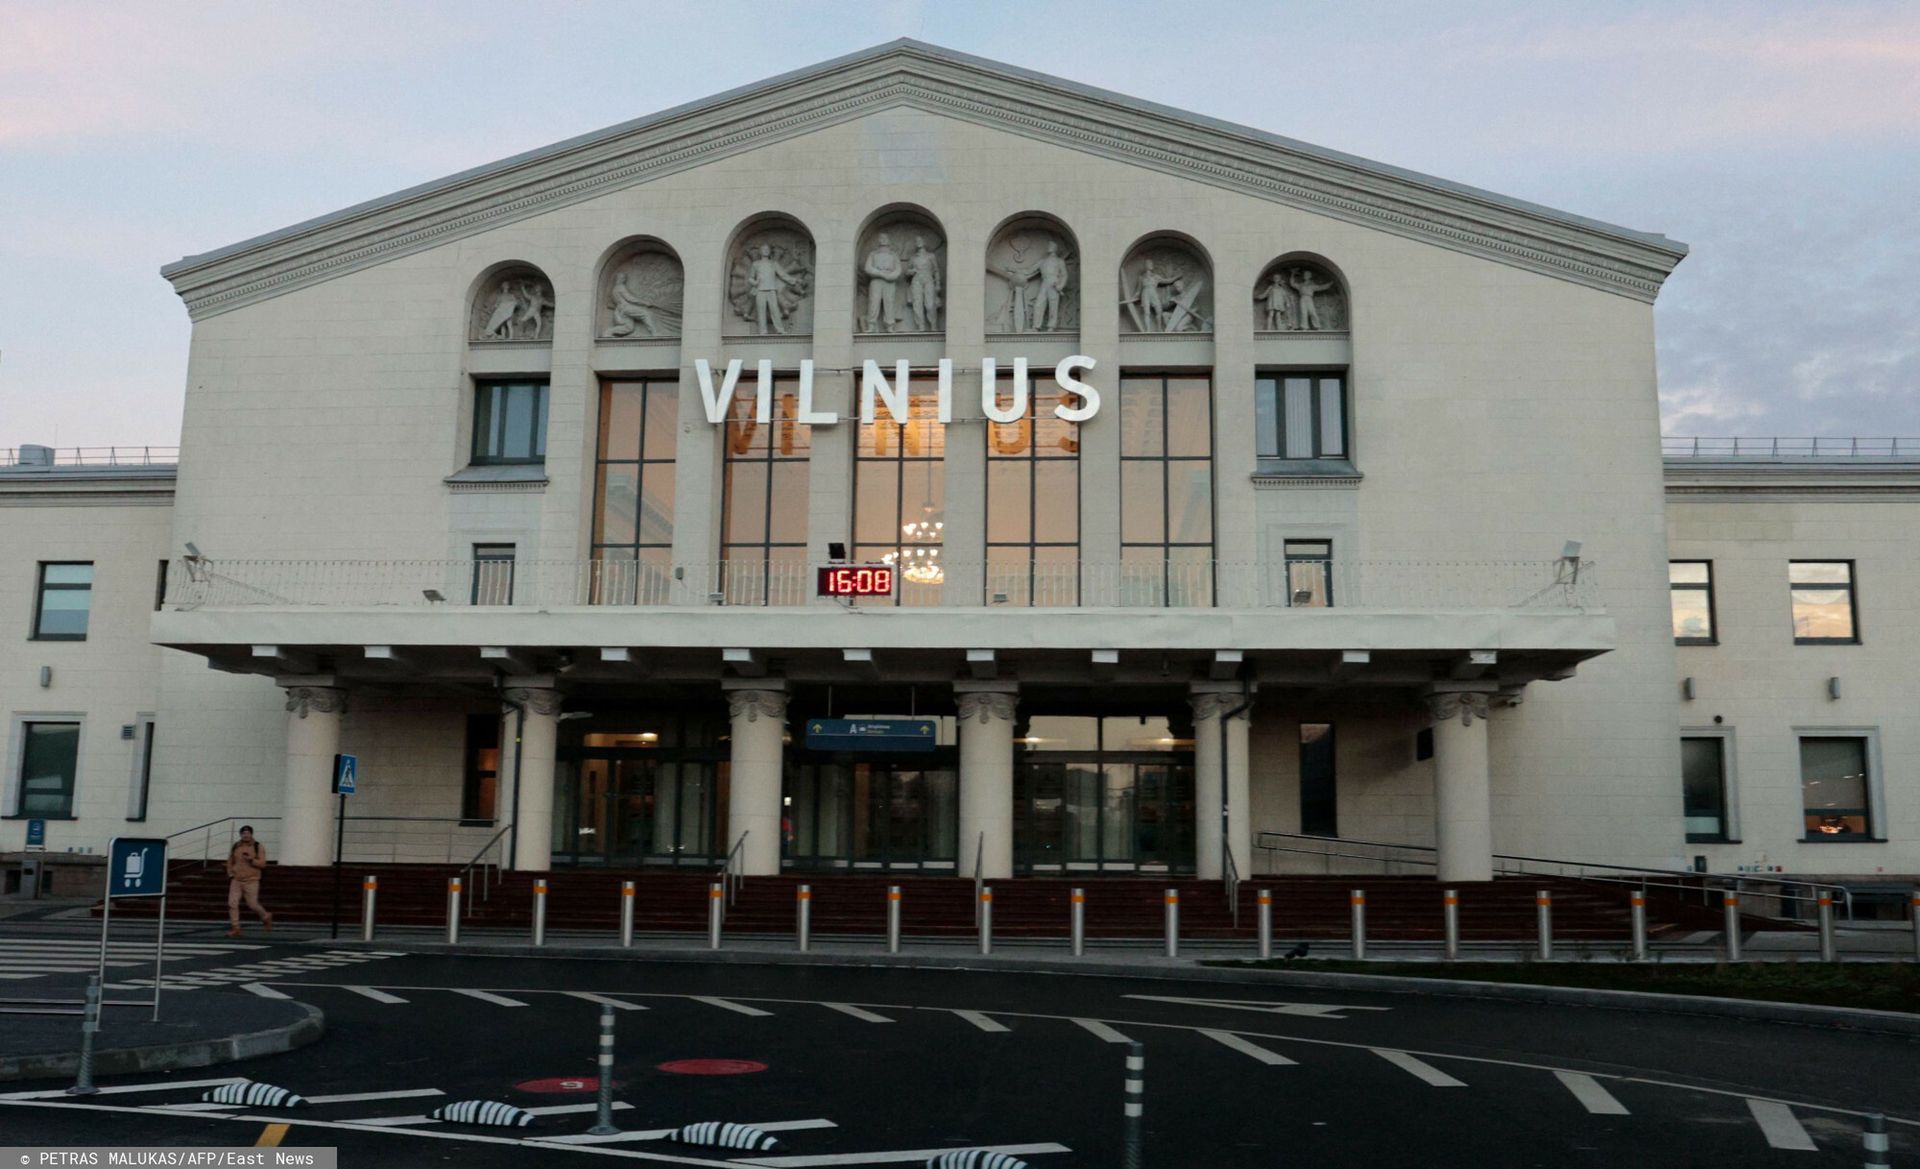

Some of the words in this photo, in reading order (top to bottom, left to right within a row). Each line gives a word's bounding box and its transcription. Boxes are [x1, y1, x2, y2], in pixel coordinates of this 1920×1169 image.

[694, 354, 1101, 424] VILNIUS
[829, 570, 890, 593] 16:08
[849, 723, 857, 734] A
